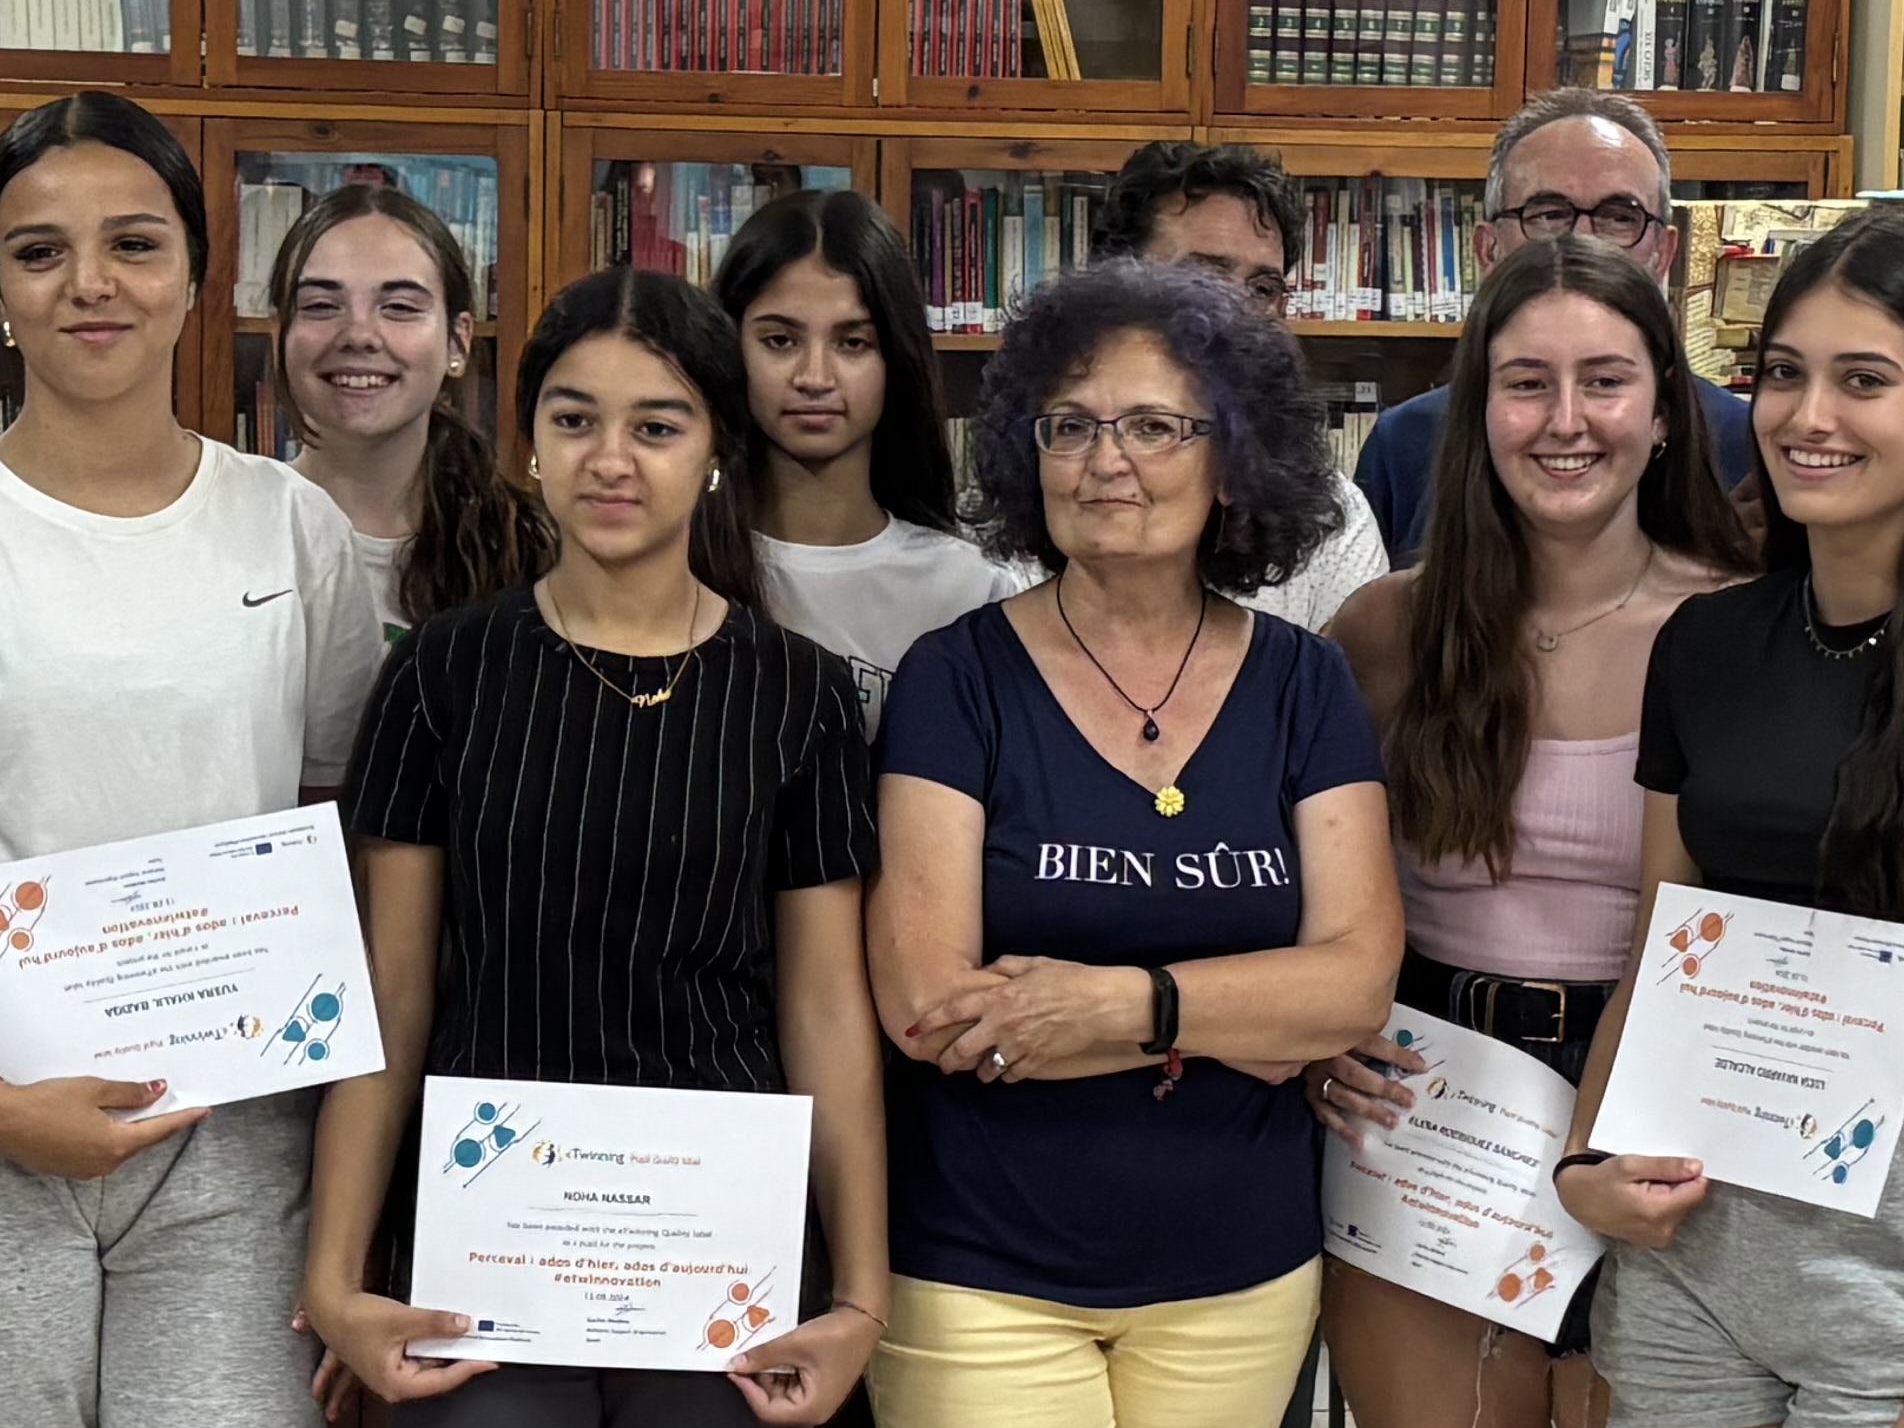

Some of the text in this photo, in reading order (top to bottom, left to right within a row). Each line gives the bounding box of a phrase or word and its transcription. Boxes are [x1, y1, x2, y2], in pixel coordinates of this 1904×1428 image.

[1033, 841, 1292, 890] BIEN SÛR!
[563, 1191, 598, 1202] NOHA
